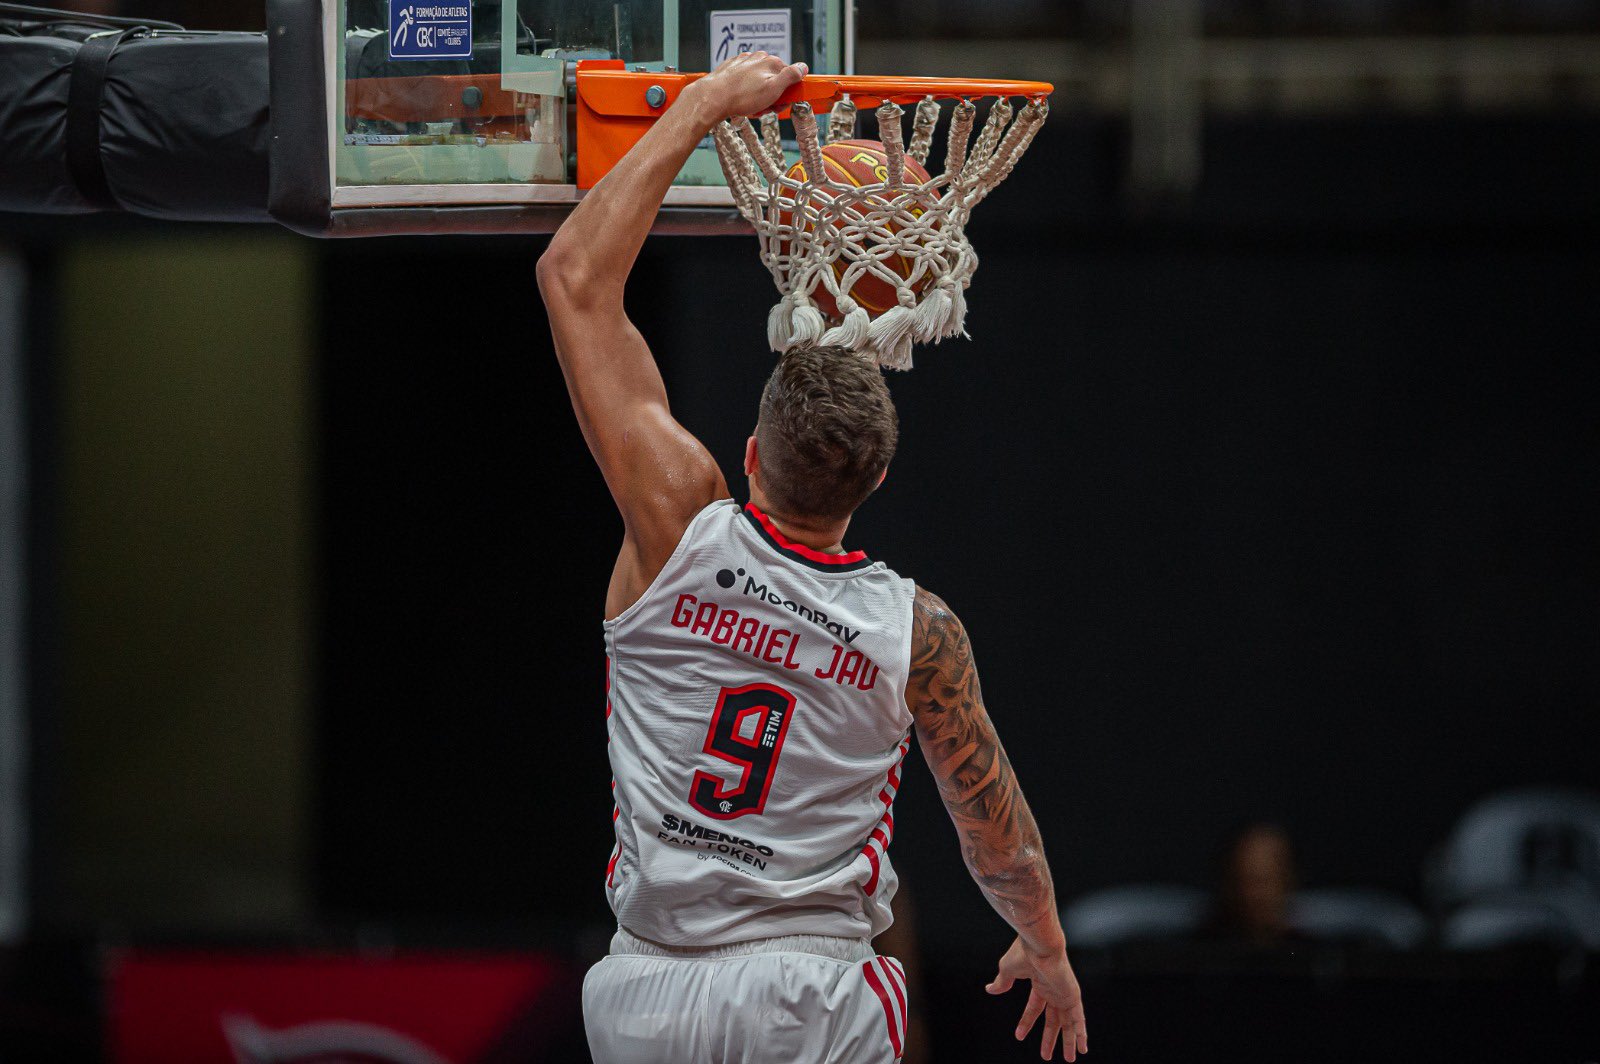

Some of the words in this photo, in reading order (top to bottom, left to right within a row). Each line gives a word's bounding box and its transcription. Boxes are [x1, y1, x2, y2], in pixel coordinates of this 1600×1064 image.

[448, 7, 468, 17] ATLETAS
[416, 26, 433, 47] CBC
[743, 576, 861, 644] MoonPay
[671, 594, 801, 670] GABRIEL
[815, 644, 879, 691] JAU
[766, 710, 783, 733] TIM
[688, 682, 797, 820] 9
[657, 831, 696, 846] FAN
[705, 841, 767, 871] TOKEN
[697, 852, 710, 862] by
